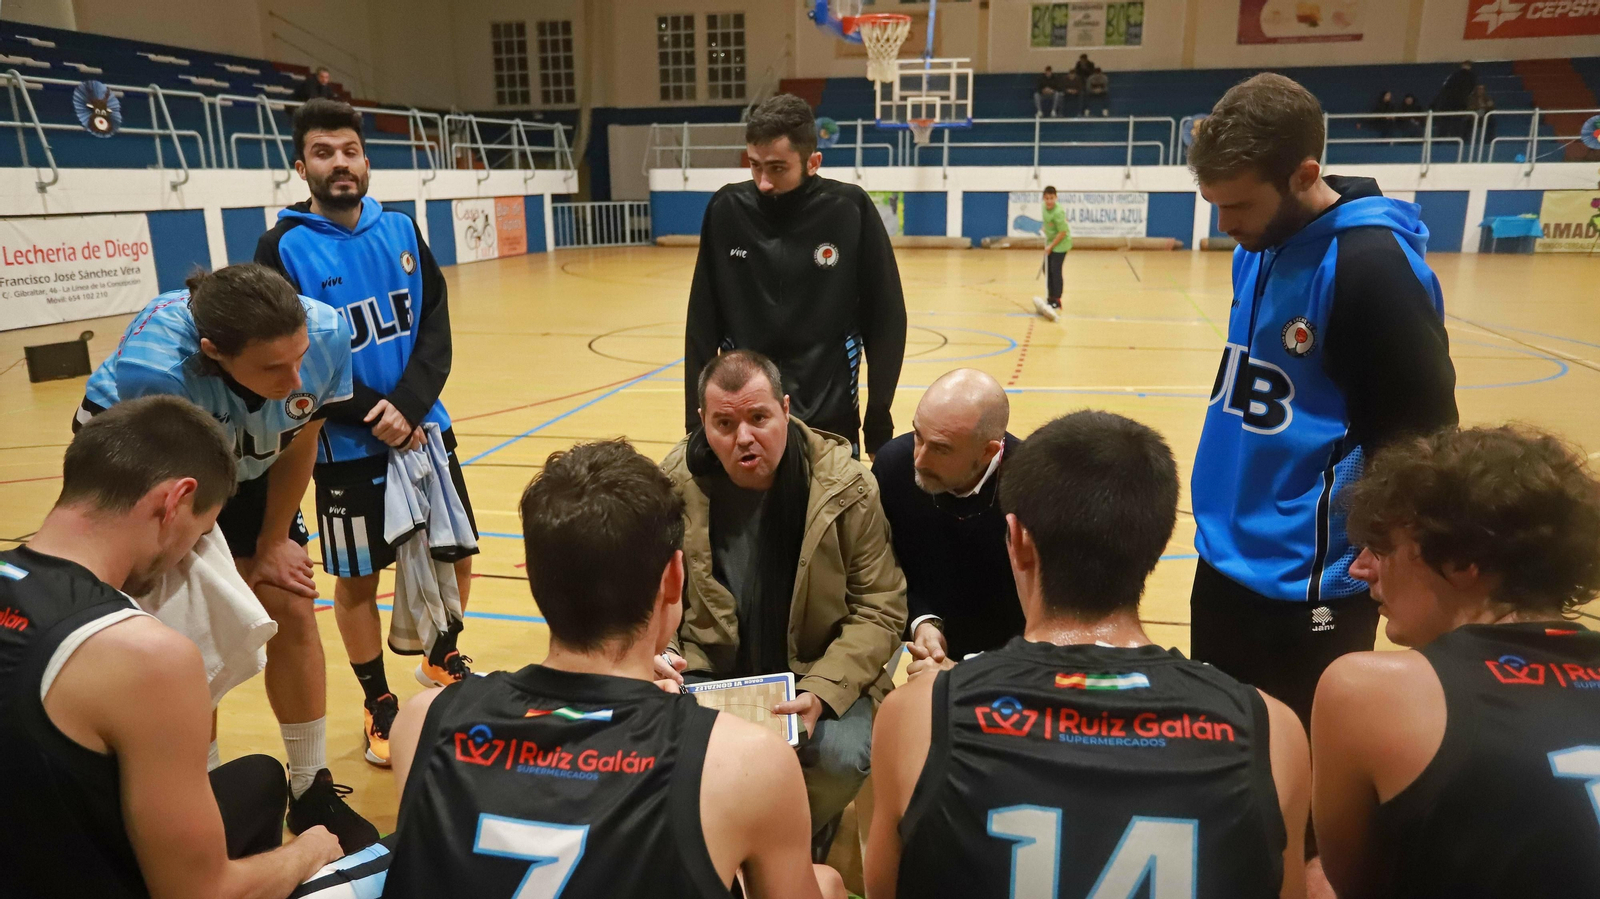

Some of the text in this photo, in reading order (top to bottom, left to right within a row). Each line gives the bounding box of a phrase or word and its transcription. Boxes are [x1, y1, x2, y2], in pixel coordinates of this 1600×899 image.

[1079, 208, 1117, 223] BALLENA
[1121, 208, 1143, 223] AZUL
[2, 239, 149, 266] Lecheria de Diego
[0, 266, 141, 287] Francisco José Sánchez Vera
[1058, 708, 1235, 742] Ruiz Galán
[1058, 733, 1167, 747] SUPERMERCADOS
[519, 741, 656, 774] Ruiz Galán
[516, 764, 599, 780] SUPERMERCADOS
[473, 812, 591, 899] 7
[987, 804, 1199, 899] 14
